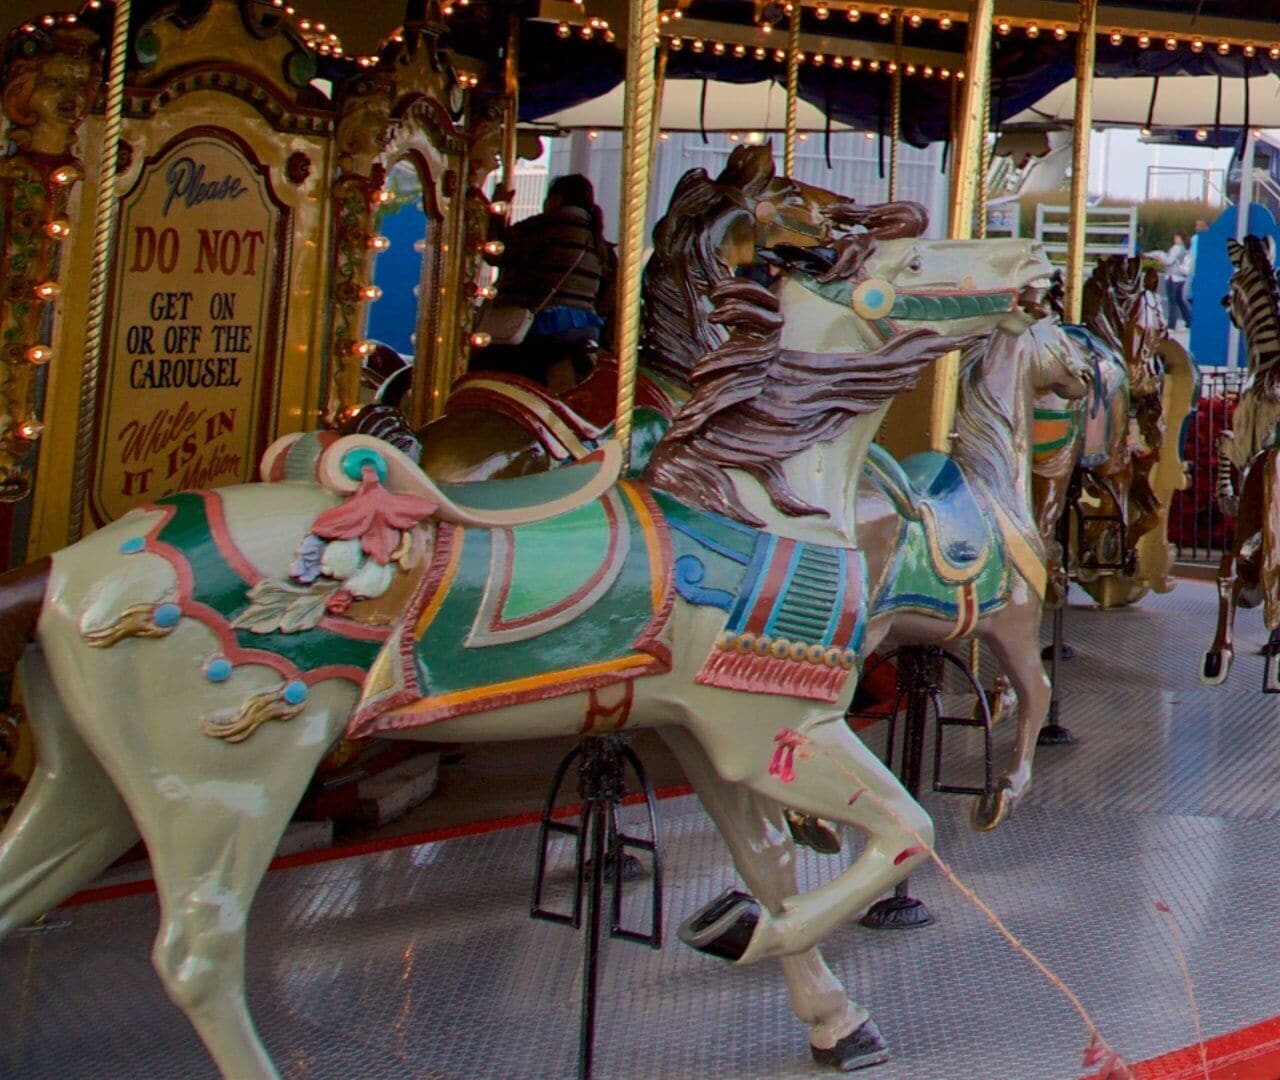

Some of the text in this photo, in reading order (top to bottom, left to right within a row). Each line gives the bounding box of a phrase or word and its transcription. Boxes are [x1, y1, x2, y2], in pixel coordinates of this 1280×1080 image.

[162, 157, 248, 217] Please
[130, 226, 264, 275] DO NOT
[150, 292, 236, 321] GET ON
[126, 325, 252, 354] OR OFF THE
[129, 358, 242, 389] CAROUSEL
[118, 400, 207, 464] While
[121, 408, 237, 496] IT IS IN
